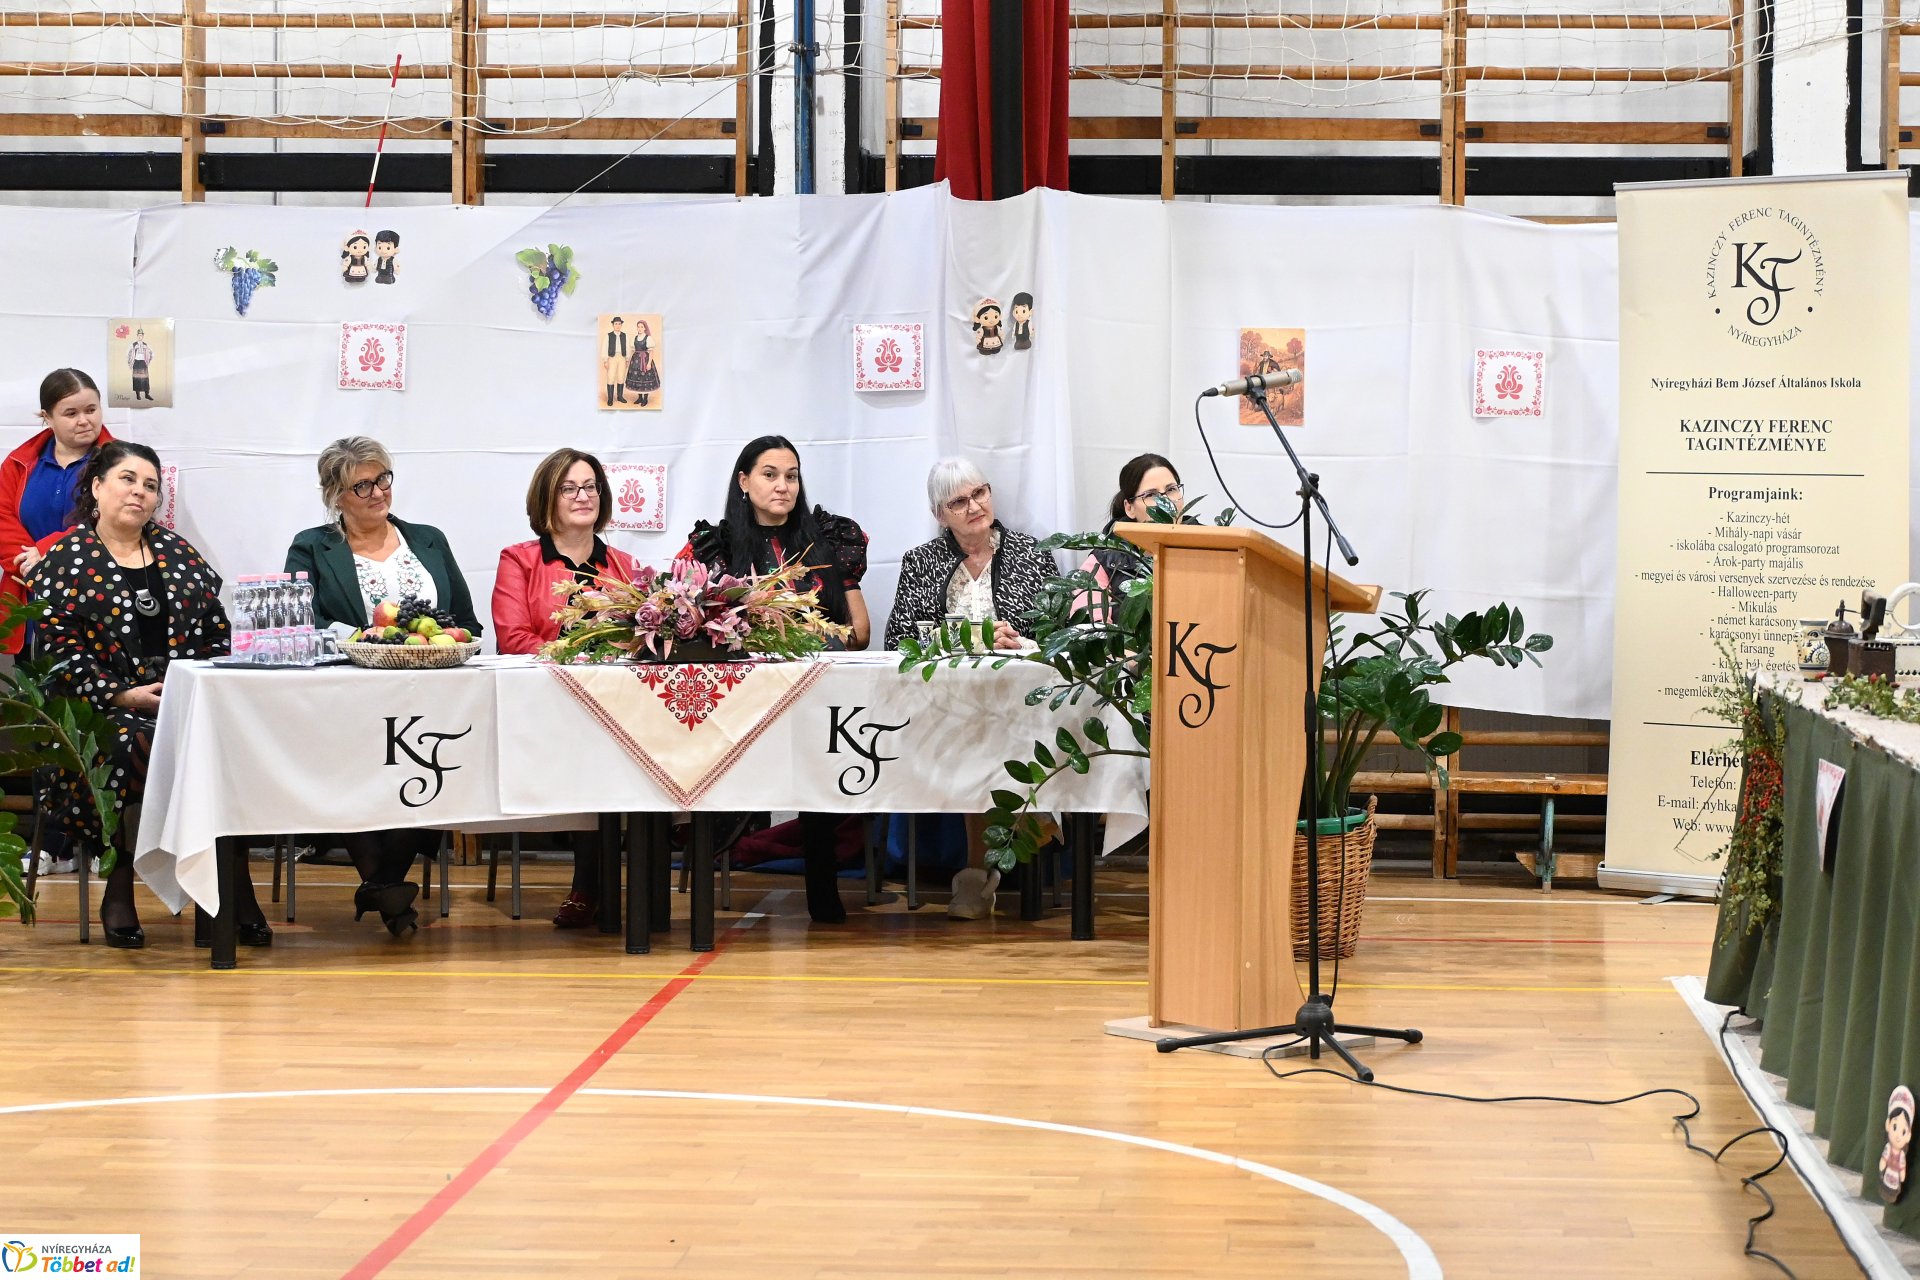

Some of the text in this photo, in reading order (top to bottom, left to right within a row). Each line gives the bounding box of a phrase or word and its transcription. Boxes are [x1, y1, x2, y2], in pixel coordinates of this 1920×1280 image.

[1706, 207, 1825, 299] KAZINCZY FERENC TAGINTÉZMÉNY
[1727, 325, 1802, 348] NYÍREGYHÁZA
[1651, 375, 1861, 391] Nyíregyházi Bem József Általános Iskola
[1680, 419, 1832, 435] KAZINCZY FERENC
[1686, 434, 1826, 451] TAGINTÉZMÉNYE
[1709, 487, 1802, 503] Programjaink:
[1727, 512, 1790, 526] Kazinczy-hét
[1715, 527, 1802, 541] Mihály-napi vásár
[1677, 539, 1839, 556] iskolába csalogató programsorozat
[1713, 553, 1803, 570] Árok-party majális
[1641, 570, 1875, 587] megyei és városi versenyek szervezése és rendezése
[1718, 585, 1797, 602] Halloween-party
[1739, 600, 1777, 613] Mikulás
[1718, 614, 1797, 631] német karácsony
[1709, 627, 1761, 641] karácsonyi
[1740, 643, 1774, 657] farsang
[1766, 660, 1796, 671] égetés
[1702, 672, 1730, 686] anyák
[1690, 776, 1736, 790] Telefon:
[1658, 795, 1699, 809] E-mail:
[1672, 818, 1701, 831] Web:
